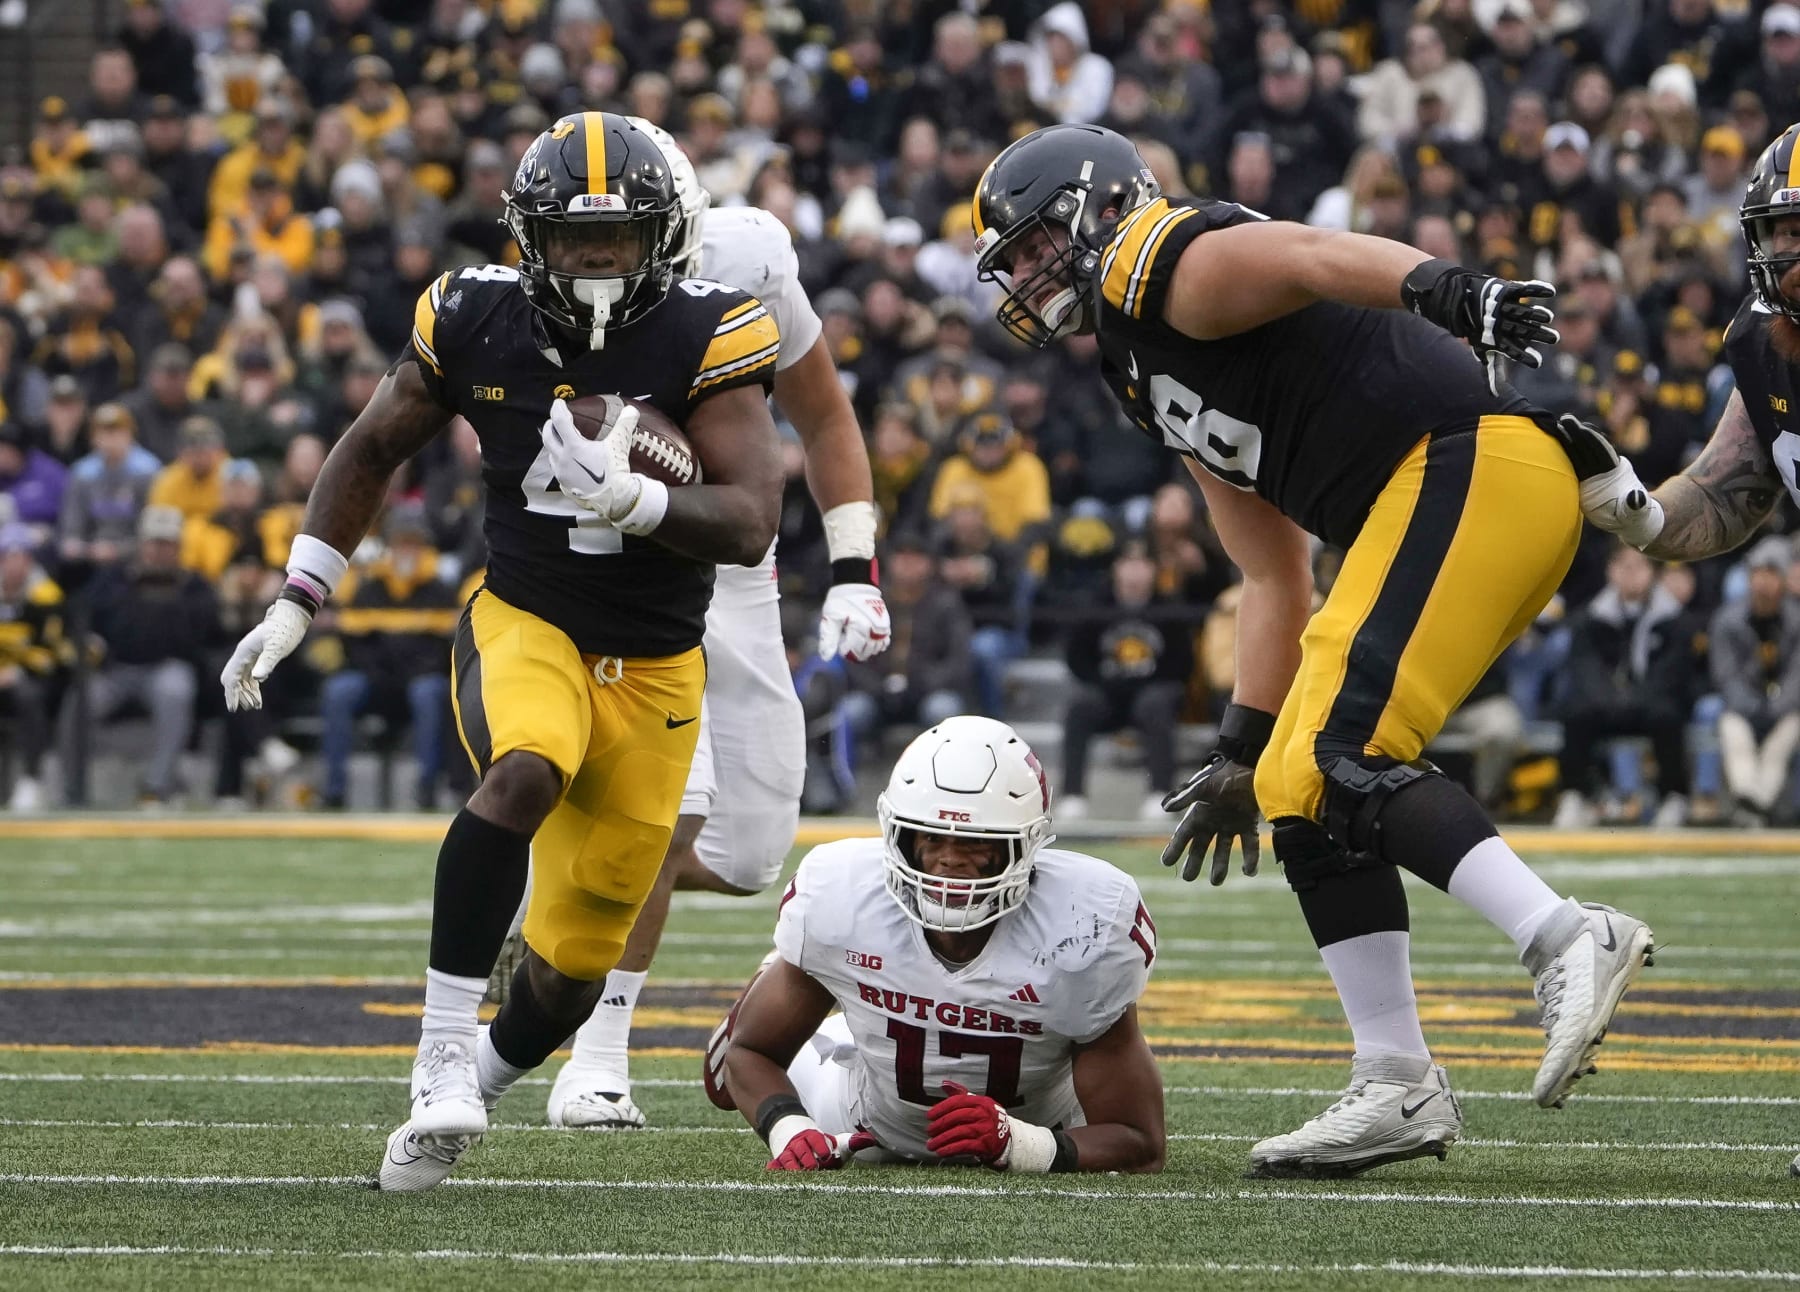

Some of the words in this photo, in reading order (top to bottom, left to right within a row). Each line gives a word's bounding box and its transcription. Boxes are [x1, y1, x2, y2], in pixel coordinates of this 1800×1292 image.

[582, 195, 613, 208] USA
[459, 263, 521, 282] 4
[678, 279, 740, 297] 4
[521, 445, 623, 555] 4
[857, 981, 1044, 1036] RUTGERS
[886, 1017, 1025, 1109] 17
